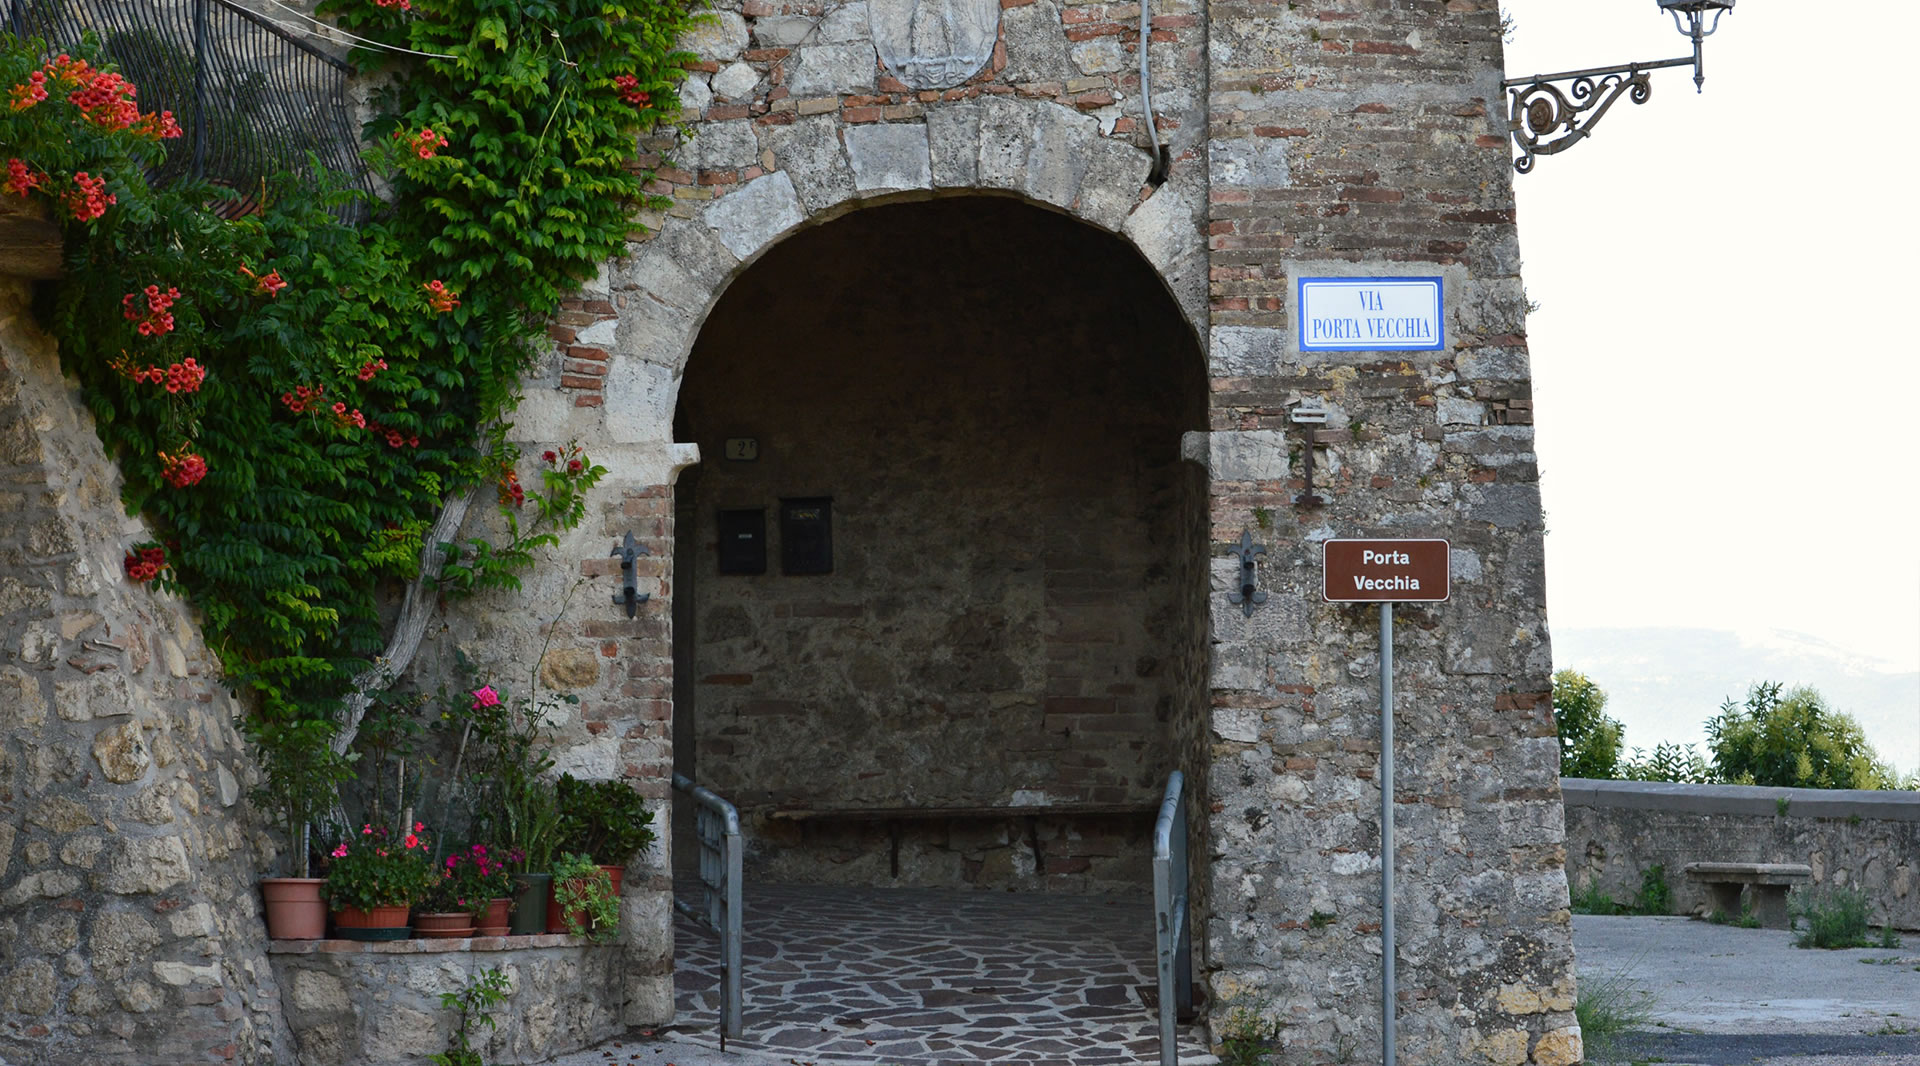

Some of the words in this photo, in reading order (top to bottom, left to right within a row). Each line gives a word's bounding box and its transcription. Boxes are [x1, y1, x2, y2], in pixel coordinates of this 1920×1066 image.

[1359, 290, 1384, 311] VIA
[1313, 318, 1361, 339] PORTA
[1366, 317, 1431, 338] VECCHIA
[1363, 550, 1410, 565] Porta
[1353, 575, 1420, 590] Vecchia
